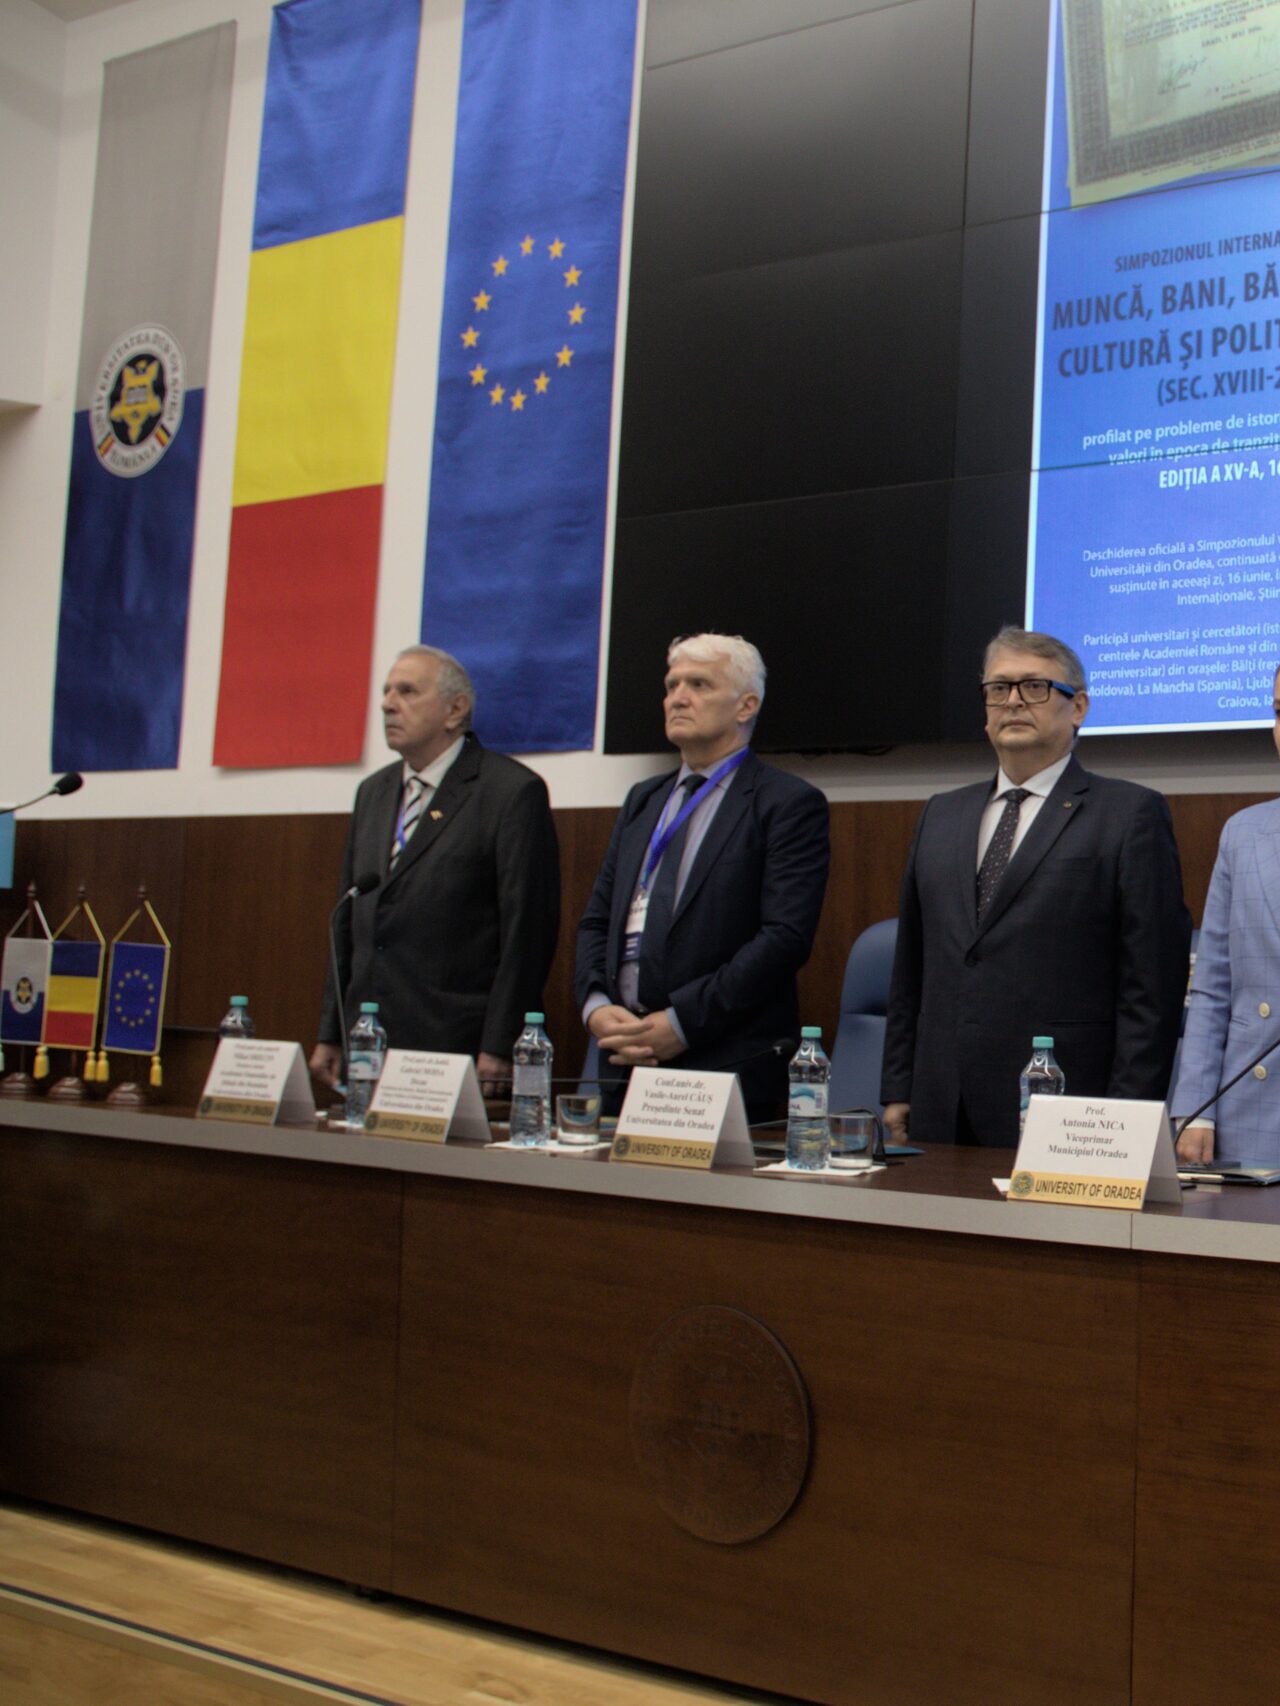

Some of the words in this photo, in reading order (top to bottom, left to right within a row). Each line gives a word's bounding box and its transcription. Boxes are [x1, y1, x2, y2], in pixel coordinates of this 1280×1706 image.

[1114, 240, 1214, 272] SIMPOZIONUL
[1052, 283, 1153, 329] MUNCĂ,
[1161, 277, 1235, 314] BANI,
[1057, 328, 1172, 378] CULTURĂ
[1179, 330, 1202, 371] ȘI
[1156, 374, 1207, 406] (SEC.
[1082, 426, 1132, 449] profilat
[1134, 427, 1152, 443] pe
[1155, 418, 1222, 441] probleme
[1225, 414, 1244, 428] de
[1108, 447, 1147, 464] valori
[1166, 445, 1208, 462] epoca
[1211, 440, 1229, 453] de
[1158, 466, 1207, 490] EDIȚIA
[1210, 464, 1221, 483] A
[1224, 460, 1264, 483] XV-A,
[1082, 546, 1146, 561] Deschiderea
[1147, 541, 1186, 555] oficială
[1188, 543, 1195, 552] a
[1196, 534, 1274, 553] Simpozionului
[1083, 631, 1129, 646] Participă
[1130, 627, 1190, 642] universitari
[1202, 623, 1260, 637] cercetători
[1085, 1106, 1105, 1115] Prof.
[1061, 1118, 1095, 1128] Antonia
[1099, 1120, 1125, 1130] NICA
[632, 1142, 669, 1156] UNIVERSITY
[672, 1145, 680, 1158] OF
[682, 1146, 711, 1159] ORADEA
[1066, 1133, 1114, 1144] Viceprimar
[1048, 1145, 1093, 1157] Municipiul
[1096, 1149, 1128, 1158] Oradea
[1035, 1180, 1086, 1196] UNIVERSITY
[1089, 1184, 1102, 1197] OF
[1105, 1186, 1141, 1200] ORADEA
